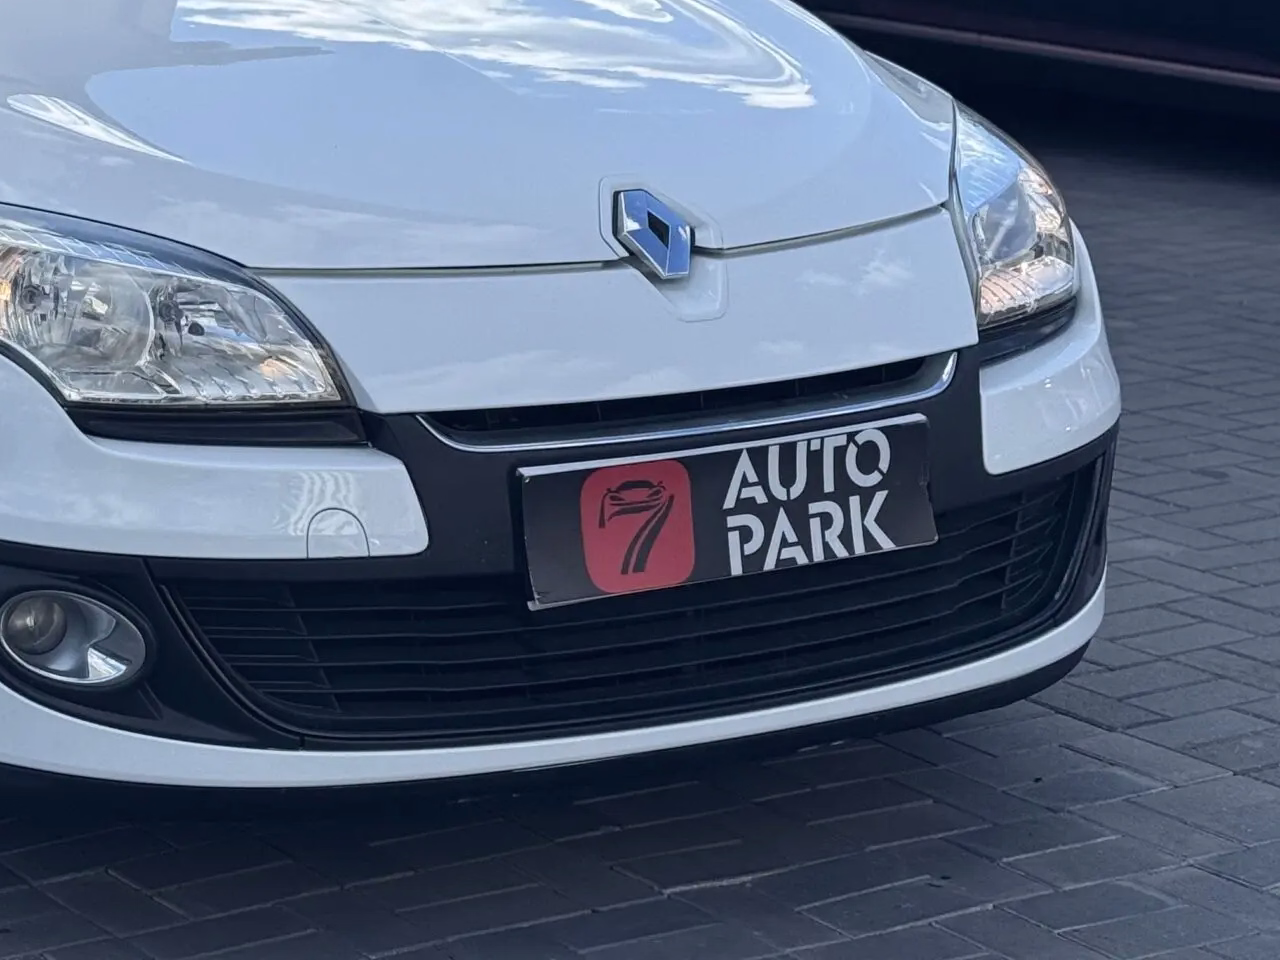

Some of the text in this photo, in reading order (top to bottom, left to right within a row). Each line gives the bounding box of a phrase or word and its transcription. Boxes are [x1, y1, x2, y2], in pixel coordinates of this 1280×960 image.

[722, 429, 891, 510] AUTO
[599, 480, 674, 576] 7
[726, 491, 896, 576] PARK
